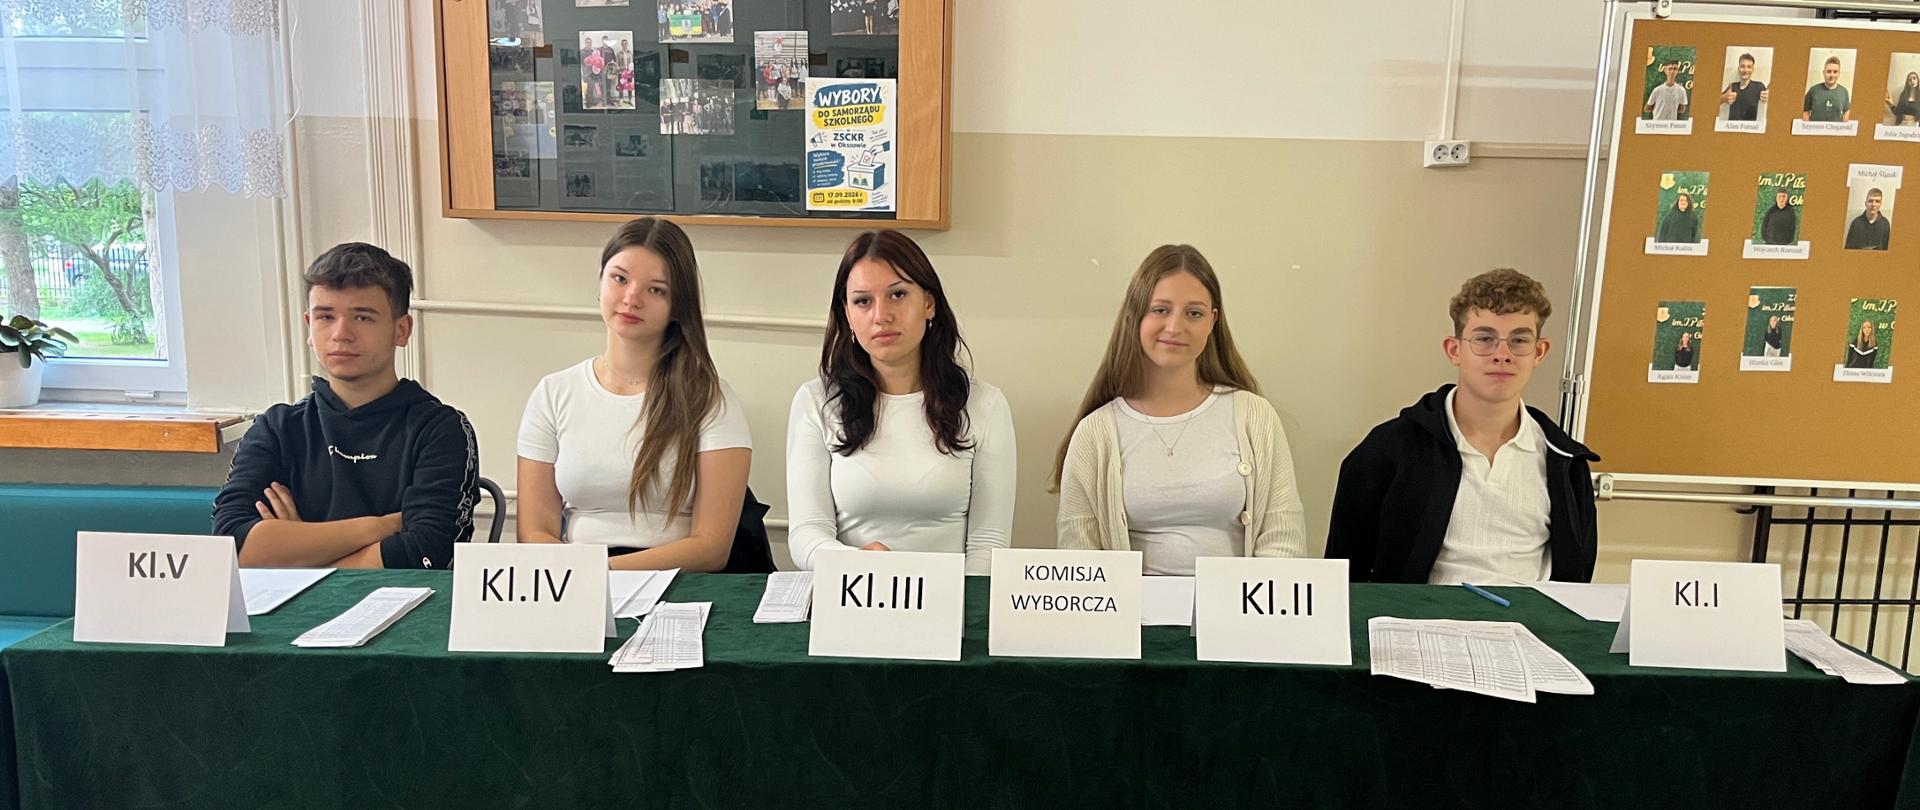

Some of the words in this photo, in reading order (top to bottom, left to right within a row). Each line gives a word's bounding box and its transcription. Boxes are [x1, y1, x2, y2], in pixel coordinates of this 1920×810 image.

[818, 86, 881, 107] WYBORY
[818, 110, 830, 118] DO
[832, 105, 880, 117] SAMORZĄDU
[823, 115, 874, 127] SZKOLNEGO
[833, 133, 865, 141] ZSCKR
[129, 552, 189, 579] Kl.V
[1024, 565, 1106, 582] KOMISJA
[482, 567, 572, 602] Kl.IV
[841, 573, 924, 610] Kl.III
[1675, 581, 1718, 608] Kl.I
[1011, 595, 1117, 612] WYBORCZA
[1242, 580, 1313, 615] Kl.II
